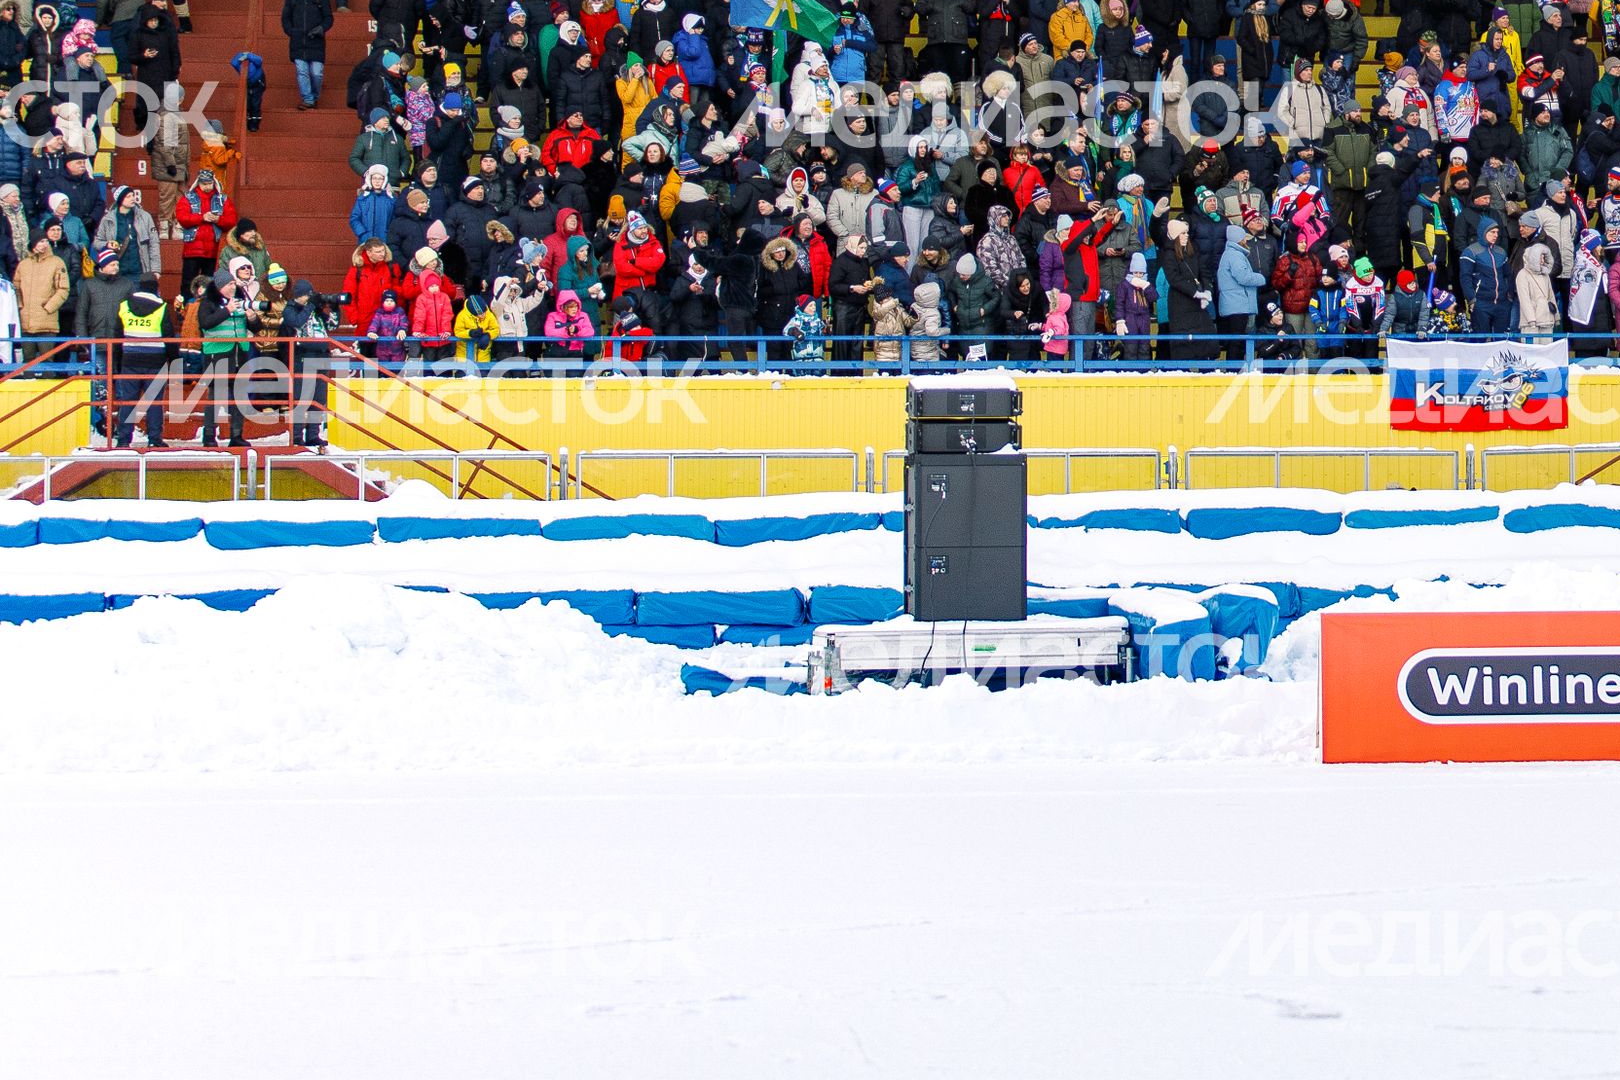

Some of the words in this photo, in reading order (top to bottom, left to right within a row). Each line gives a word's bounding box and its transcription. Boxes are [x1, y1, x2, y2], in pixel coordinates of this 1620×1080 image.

[138, 160, 147, 176] 9
[128, 318, 152, 327] 2125
[1512, 382, 1535, 409] 106
